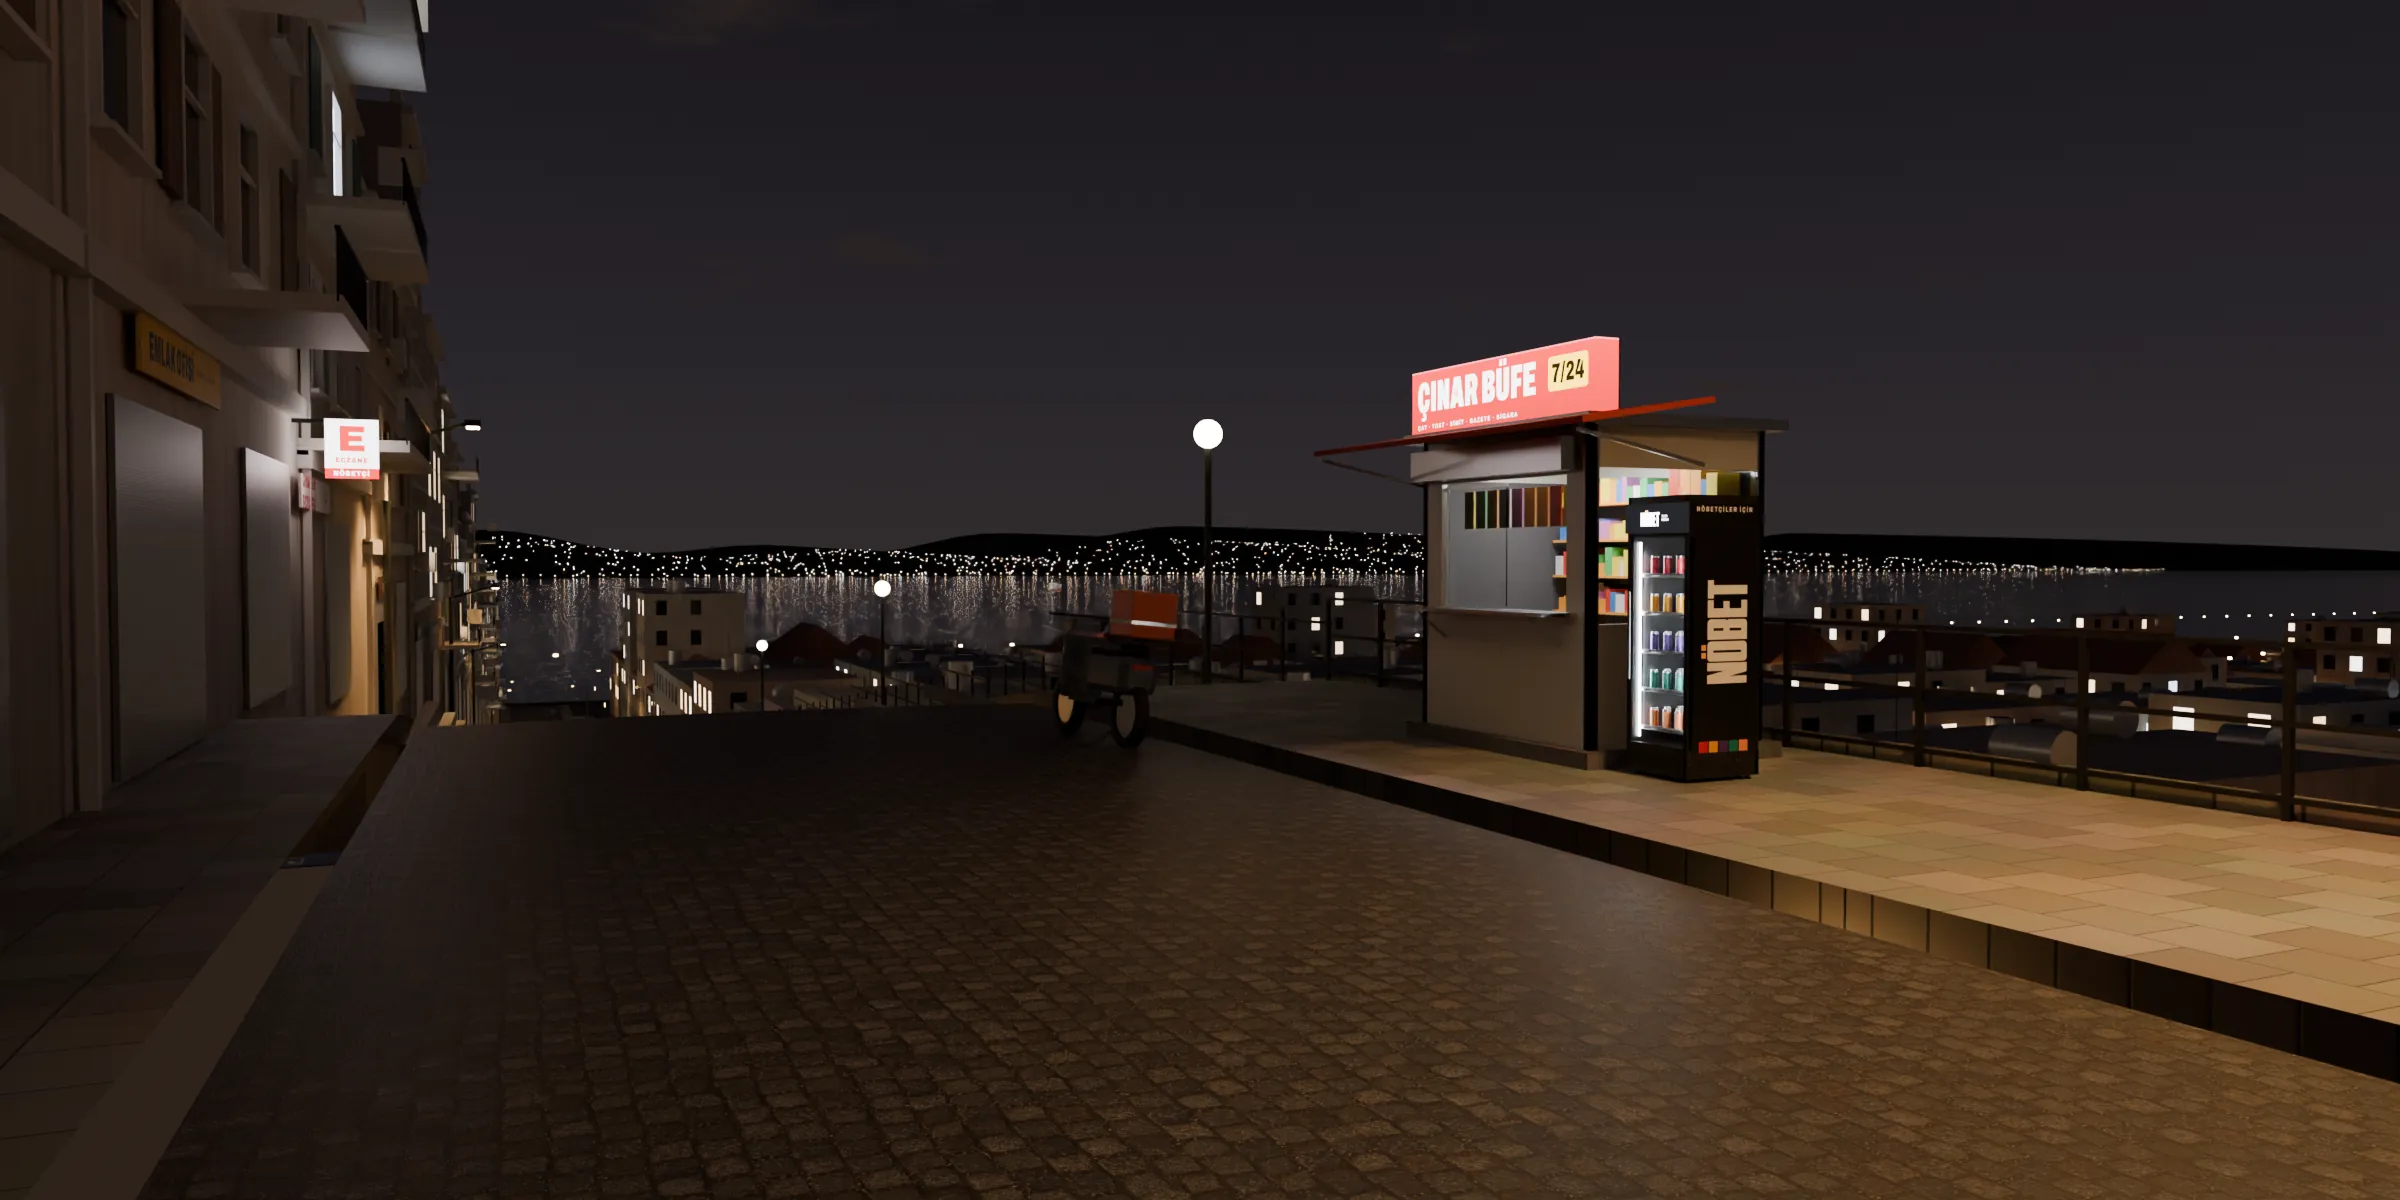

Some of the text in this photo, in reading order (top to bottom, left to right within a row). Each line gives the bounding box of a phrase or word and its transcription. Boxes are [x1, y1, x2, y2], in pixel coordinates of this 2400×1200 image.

[149, 331, 175, 373] EMLAK
[1552, 359, 1584, 383] 7/24
[1418, 358, 1536, 422] ÇINAR BÜFE
[340, 425, 364, 451] E
[1696, 505, 1754, 514] NÖBETÇİLER İÇİN
[1701, 579, 1748, 685] NÖBET
